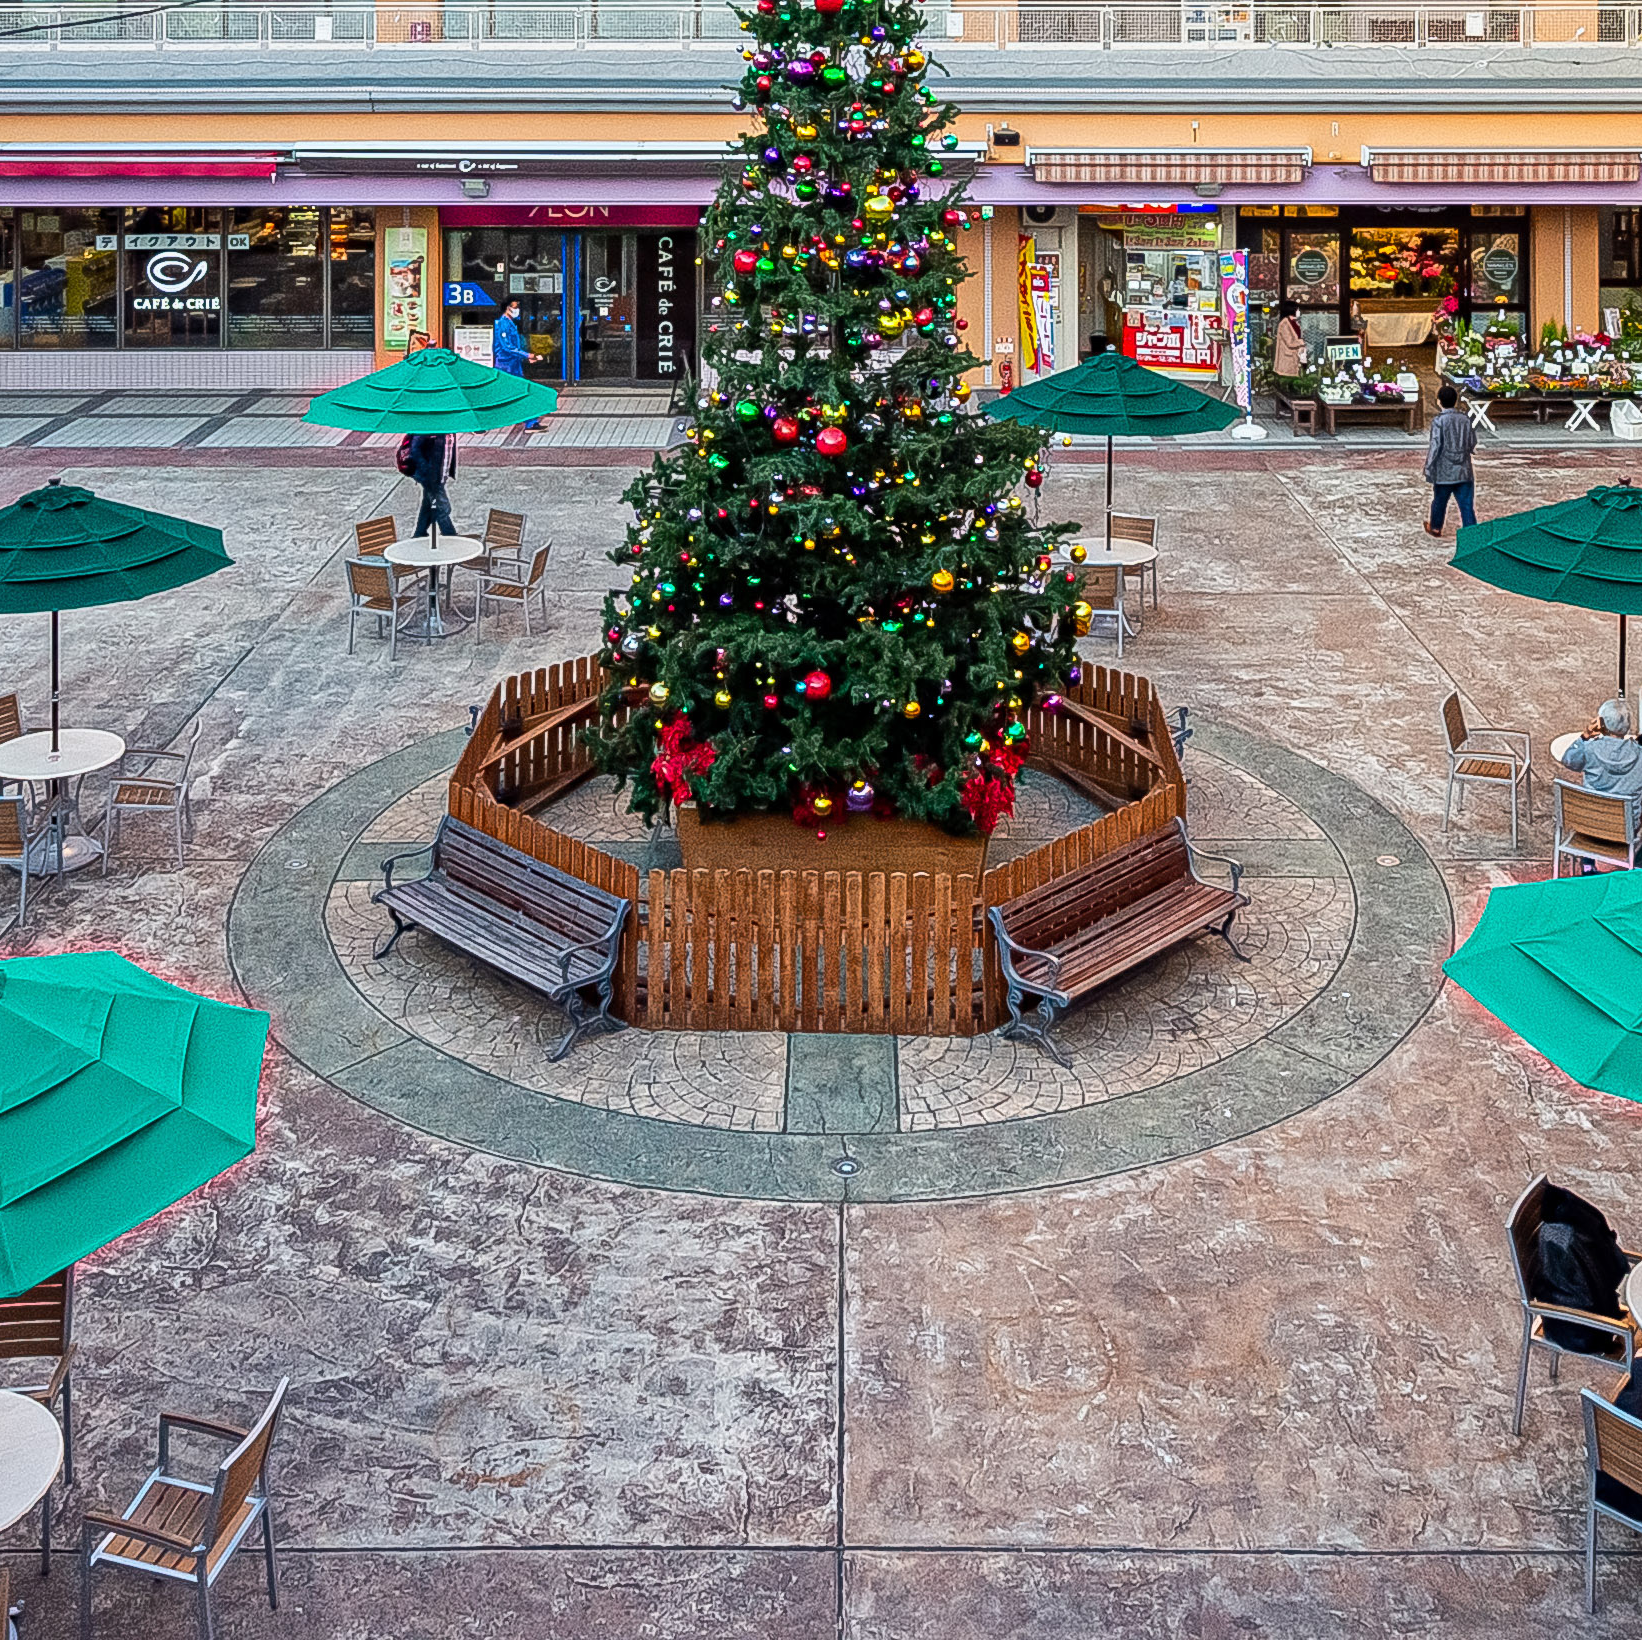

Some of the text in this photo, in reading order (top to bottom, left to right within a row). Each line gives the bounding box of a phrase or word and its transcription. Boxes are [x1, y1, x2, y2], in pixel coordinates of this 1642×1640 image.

[230, 238, 247, 247] OK
[659, 236, 677, 292] CAFÉ
[448, 284, 474, 304] 3B
[133, 297, 170, 309] CAFÉ
[186, 297, 221, 309] CRIÉ
[659, 298, 673, 315] de
[659, 321, 677, 374] CRIÉ
[1331, 346, 1359, 359] OPEN
